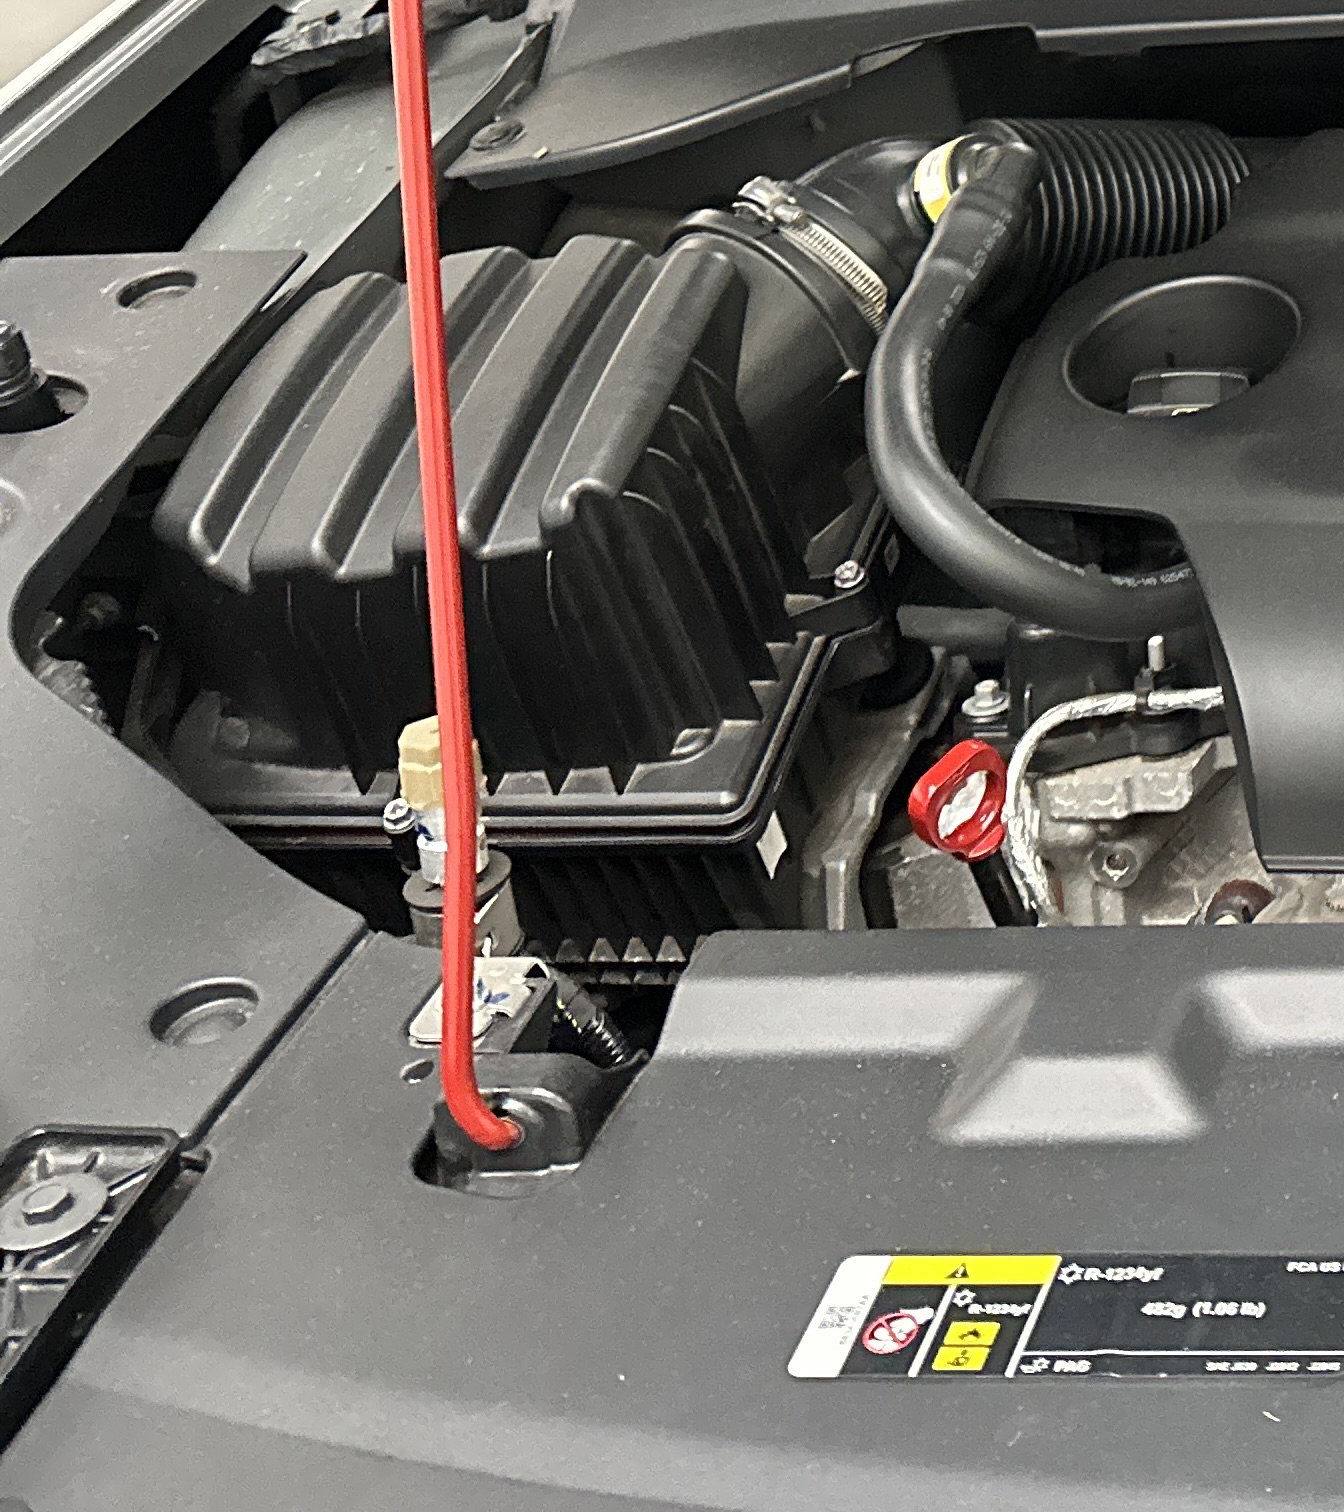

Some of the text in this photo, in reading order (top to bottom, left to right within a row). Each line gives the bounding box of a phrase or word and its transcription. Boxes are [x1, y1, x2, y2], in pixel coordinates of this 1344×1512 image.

[1083, 1265, 1164, 1283] R-1234yf
[1286, 1261, 1319, 1273] FCA
[1319, 1262, 1341, 1273] US
[967, 1303, 1033, 1317] R-1234yf
[1191, 1301, 1239, 1318] (1.06
[1239, 1301, 1267, 1319] lb)
[1053, 1359, 1092, 1373] PAG
